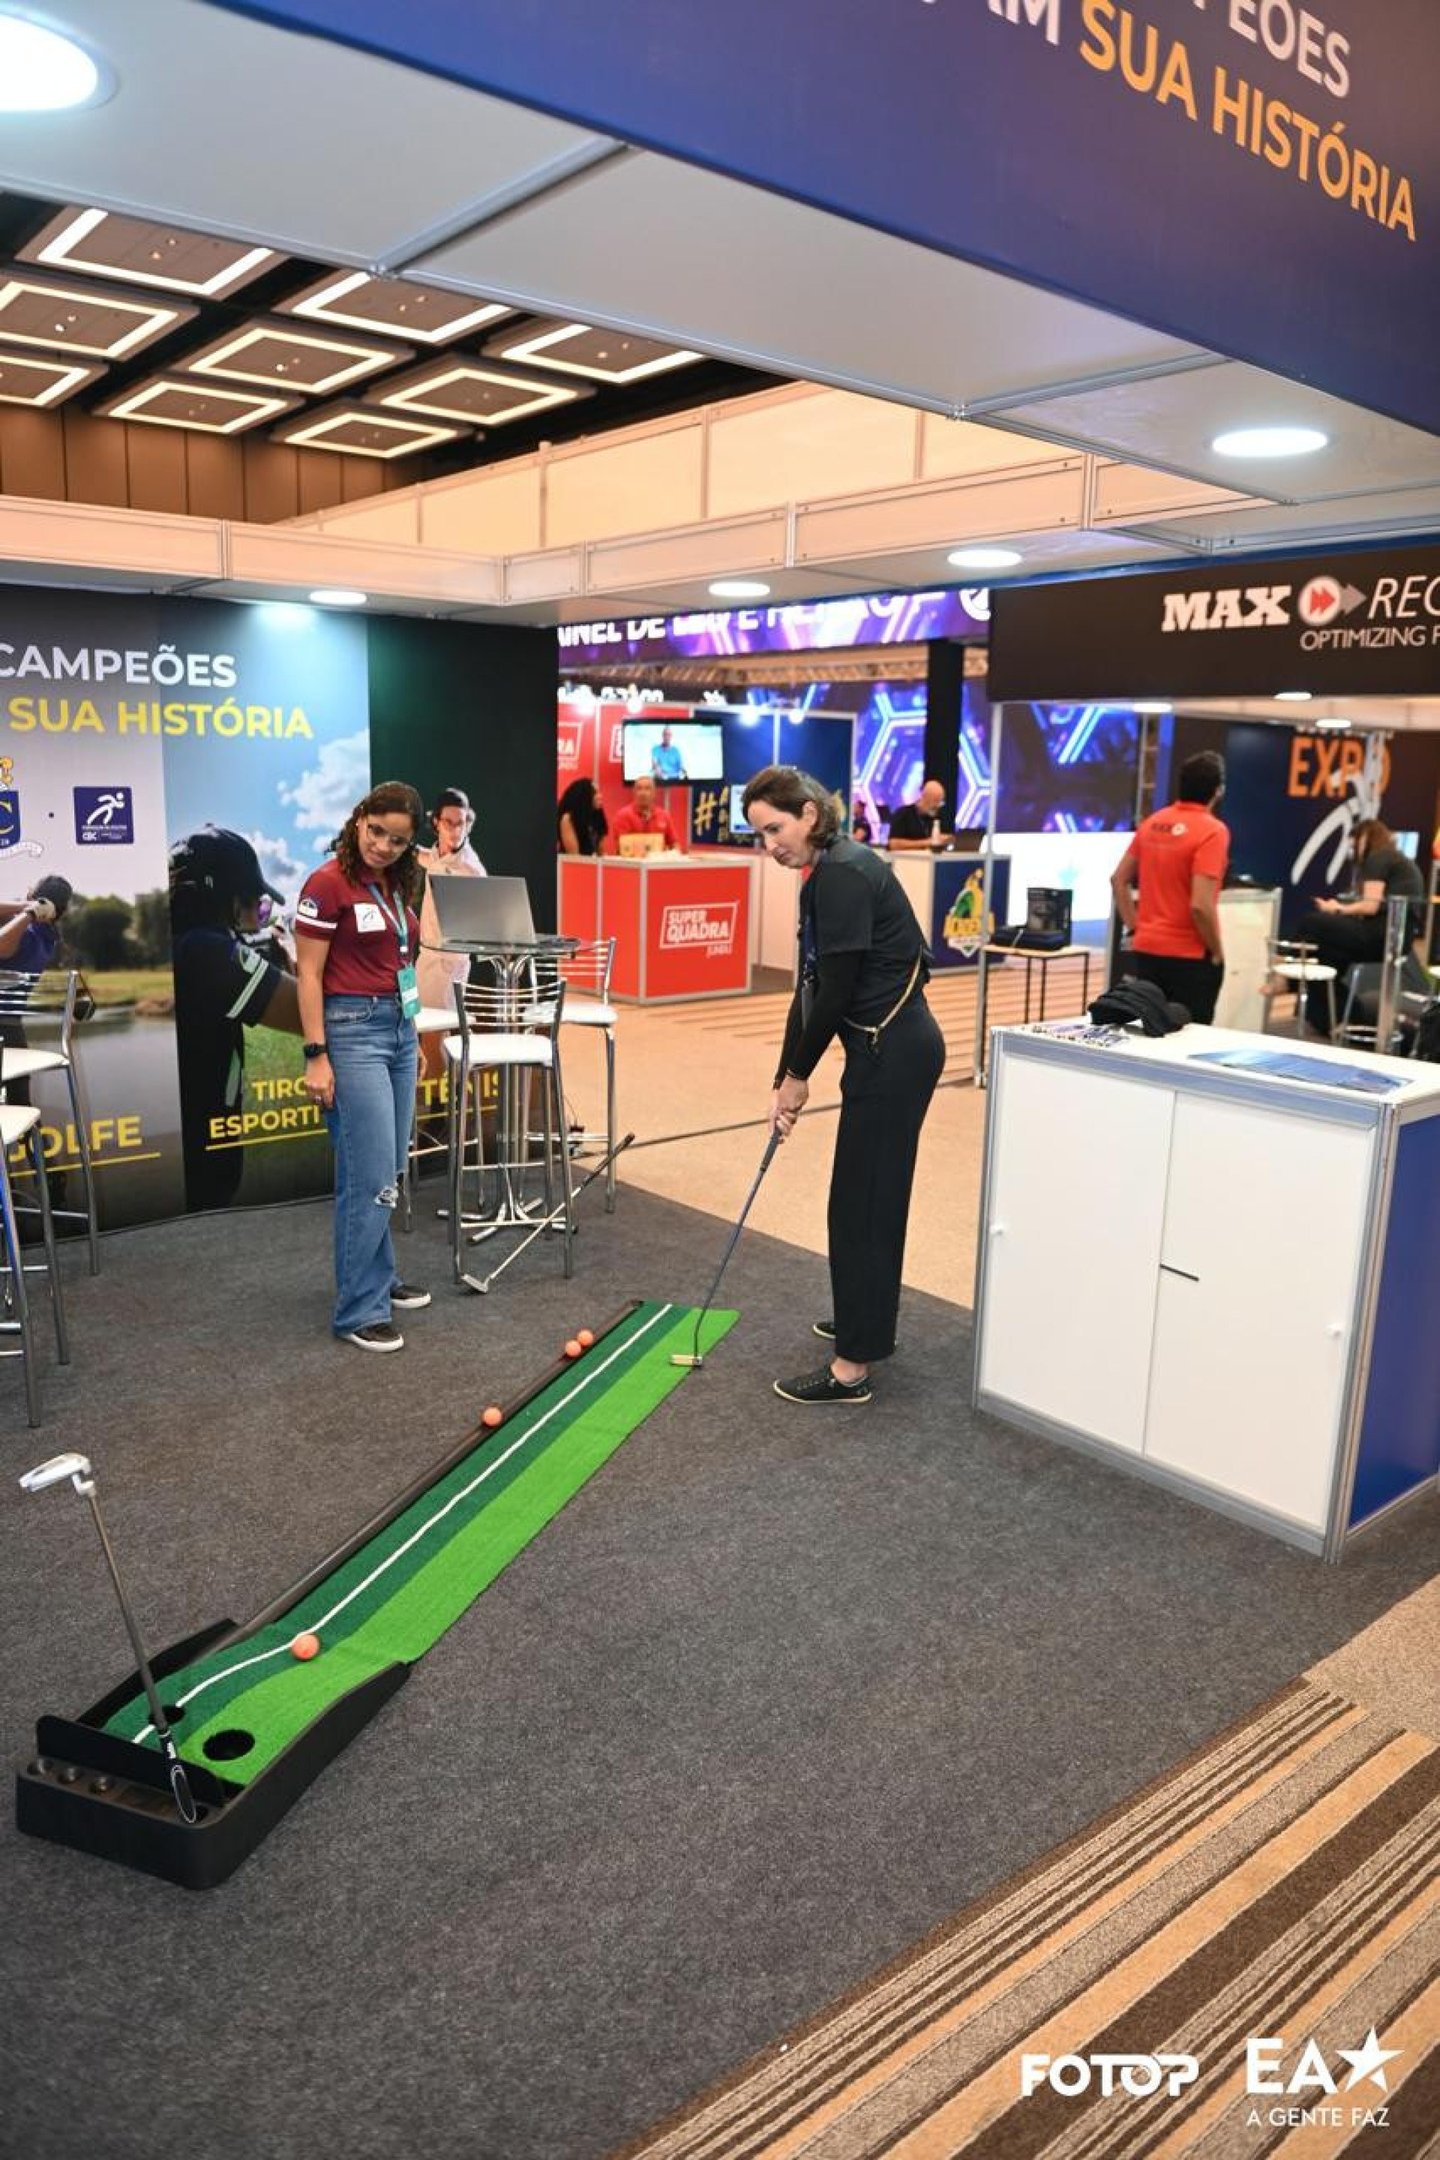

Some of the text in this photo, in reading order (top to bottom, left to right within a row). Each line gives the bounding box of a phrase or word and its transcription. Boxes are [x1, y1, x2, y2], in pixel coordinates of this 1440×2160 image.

[1080, 0, 1416, 241] SUA HISTÓRIA
[1161, 585, 1292, 632] MAX
[1300, 625, 1427, 650] OPTIMIZING
[8, 697, 315, 739] SUA HISTÓRIA
[666, 920, 730, 945] QUADRA
[209, 1105, 320, 1139] ESPORTI
